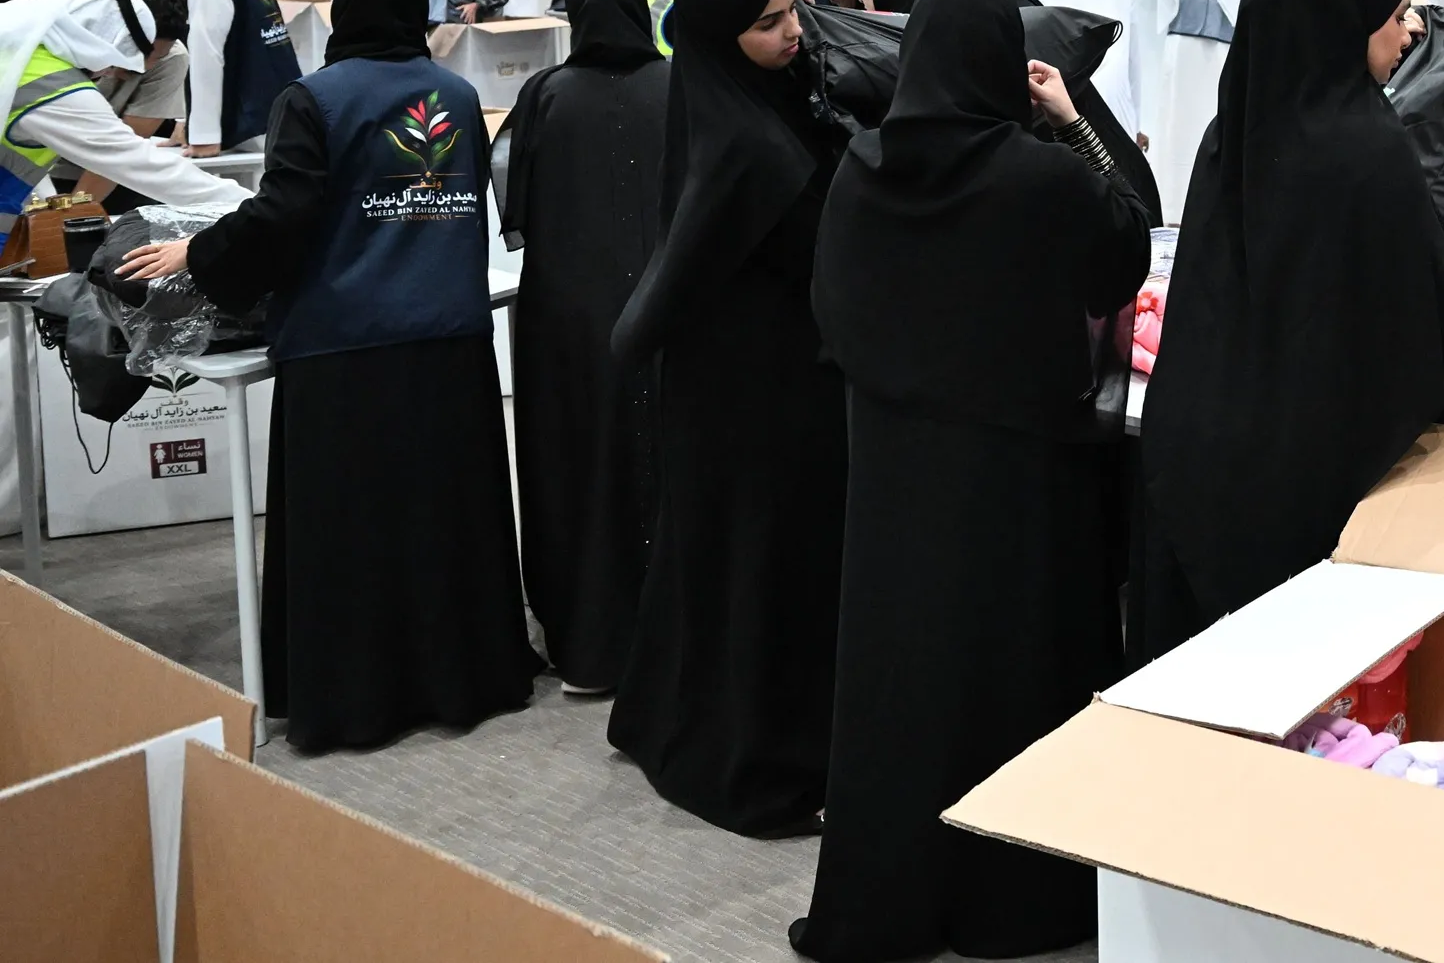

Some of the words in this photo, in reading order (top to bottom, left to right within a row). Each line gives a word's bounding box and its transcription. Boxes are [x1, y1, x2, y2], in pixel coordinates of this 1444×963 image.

[361, 192, 396, 209] نهيان
[436, 189, 451, 205] بن
[366, 209, 395, 218] SAEED
[397, 206, 413, 215] BIN
[415, 206, 438, 214] ZAYED
[401, 213, 453, 222] ENDOWMENT
[185, 406, 198, 416] بن
[200, 405, 228, 414] سعيد
[177, 450, 203, 459] WOMEN
[167, 464, 192, 474] XXL
